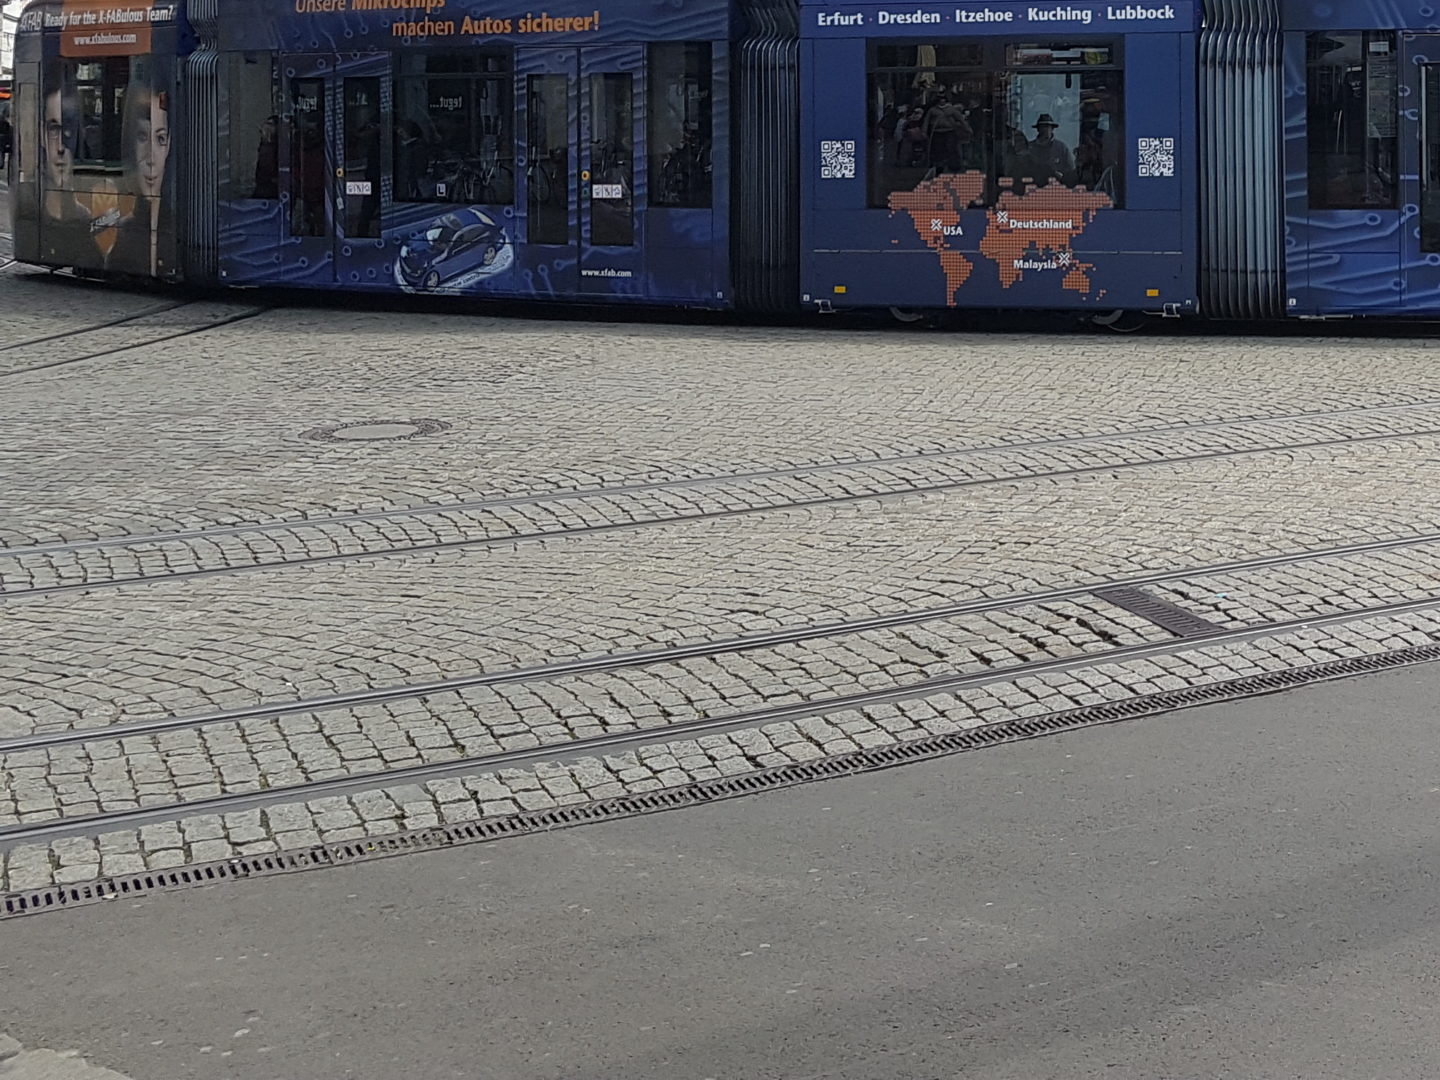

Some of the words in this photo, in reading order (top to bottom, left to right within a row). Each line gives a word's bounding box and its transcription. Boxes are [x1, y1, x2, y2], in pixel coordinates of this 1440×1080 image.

[44, 12, 66, 31] Ready
[69, 12, 82, 26] for
[83, 11, 96, 25] the
[99, 7, 143, 24] X-FABulous
[146, 4, 174, 22] Team?
[817, 11, 864, 27] Erfurt
[877, 9, 941, 25] Dresden
[955, 8, 1014, 23] Itzehoe
[1027, 6, 1093, 24] Kuching
[1107, 4, 1175, 21] Lubbock
[392, 17, 455, 37] machen
[460, 15, 513, 35] Autos
[518, 10, 600, 33] sicherer!
[1009, 219, 1073, 229] Deutschland
[943, 226, 963, 236] USA
[1013, 259, 1057, 271] Malaysia
[581, 268, 632, 278] www.xfab.com
